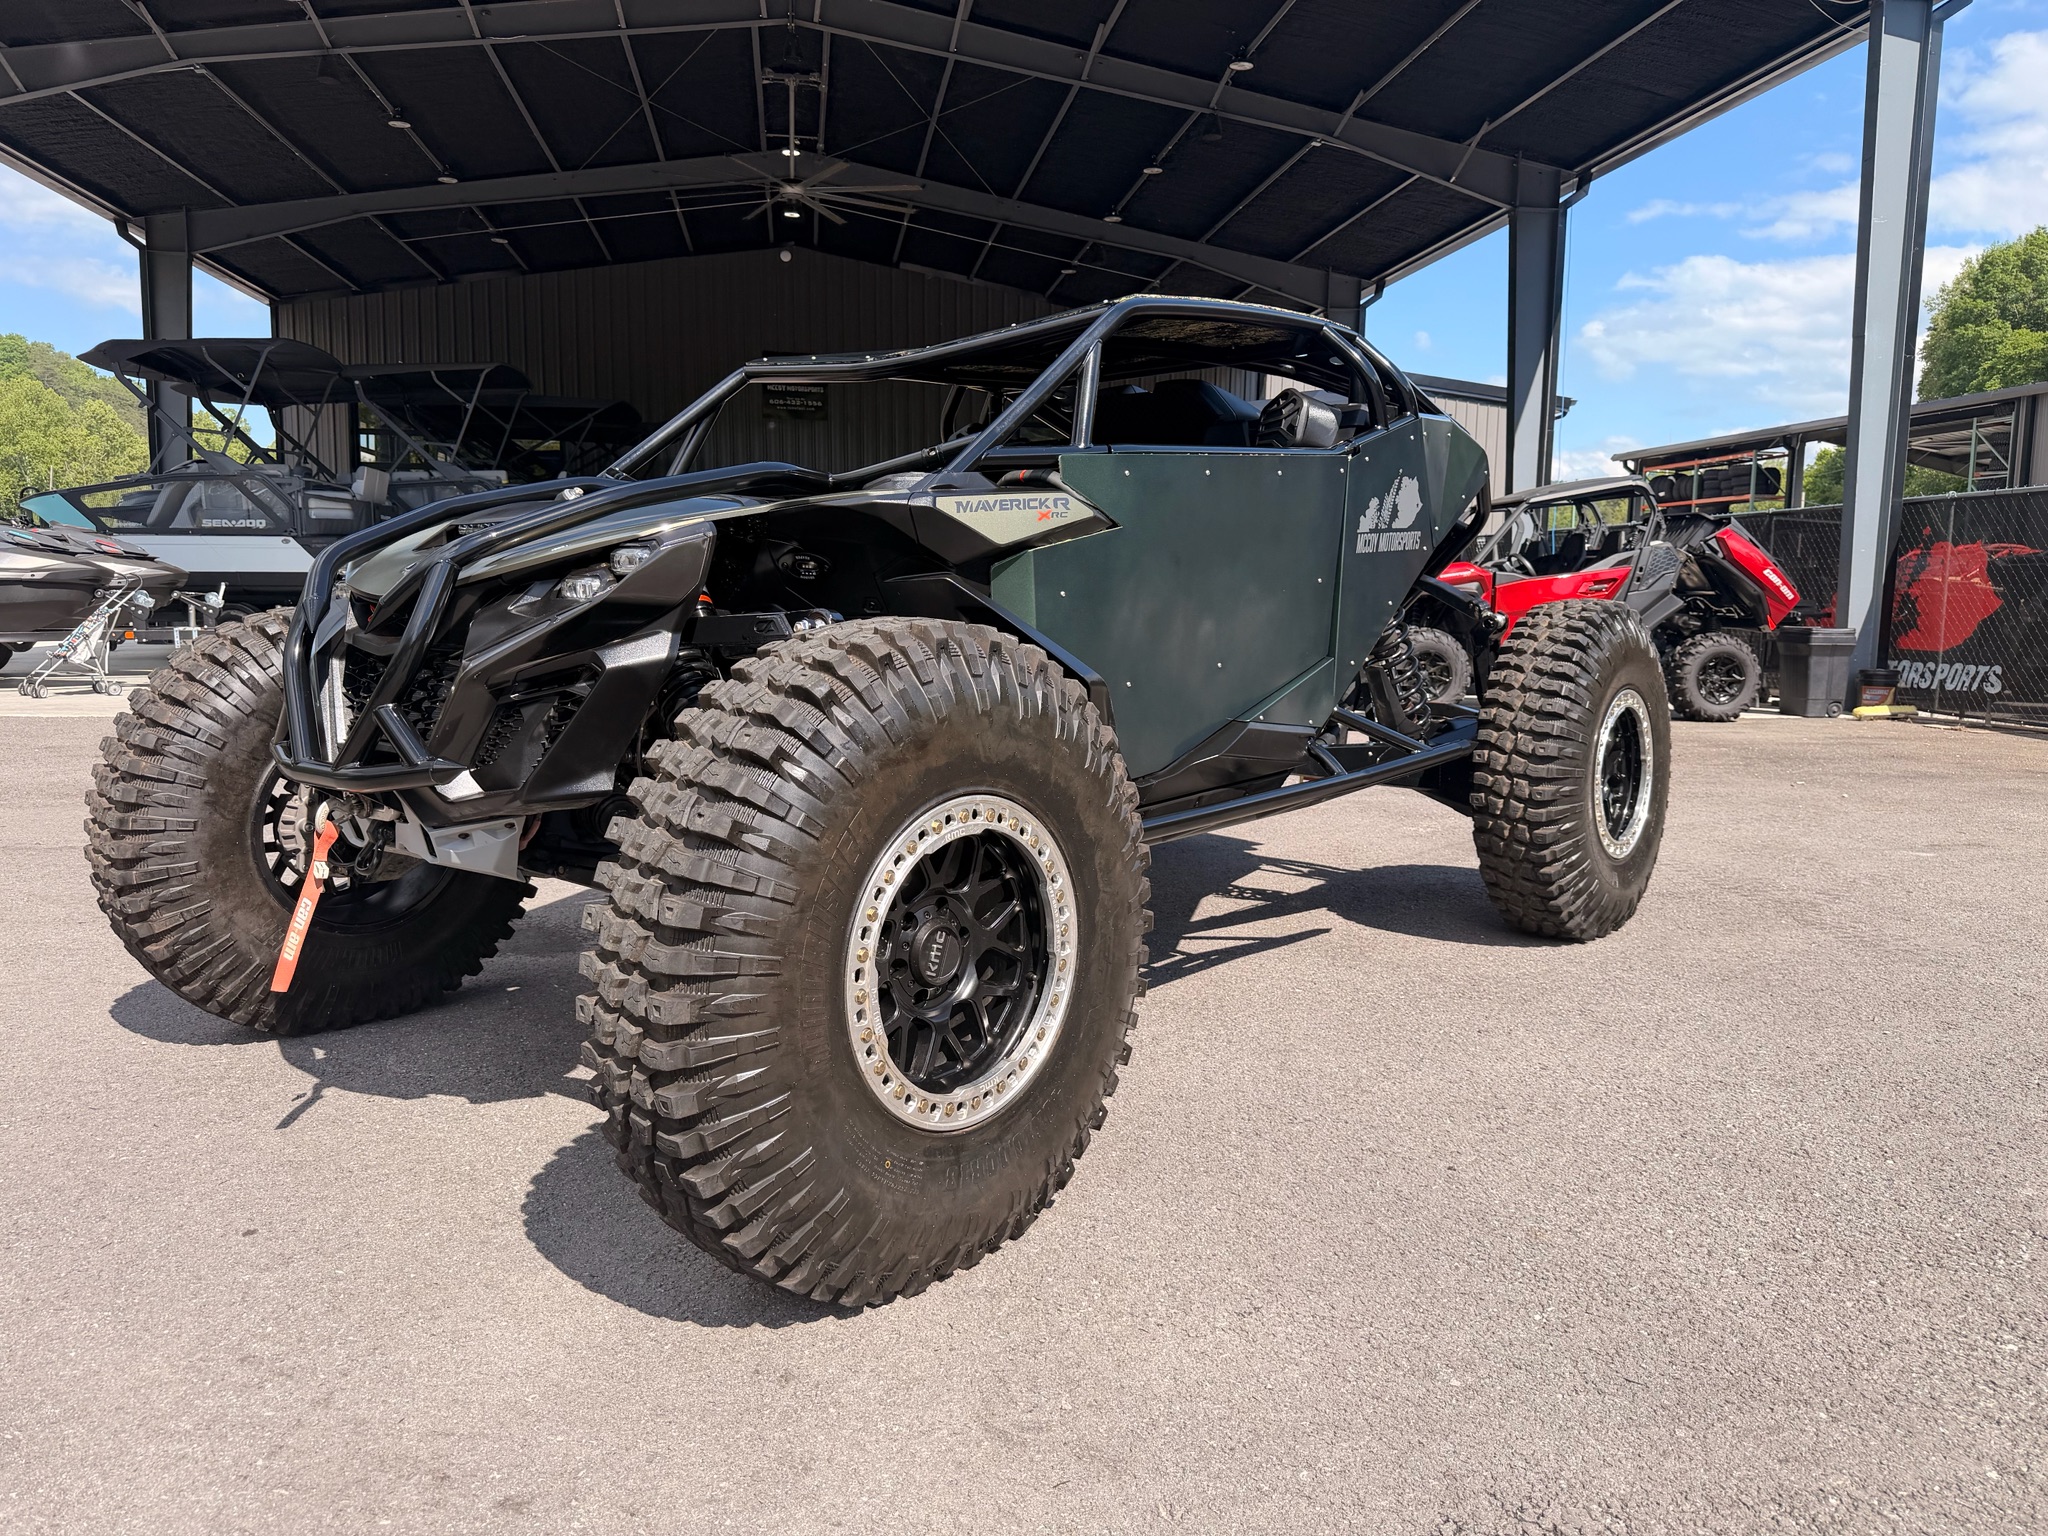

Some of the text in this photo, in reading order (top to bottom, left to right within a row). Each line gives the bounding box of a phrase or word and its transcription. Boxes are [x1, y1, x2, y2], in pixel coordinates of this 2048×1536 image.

[955, 498, 1050, 513] MAVERICK
[1356, 531, 1421, 553] MCCOY MOTORSPORTS
[925, 930, 947, 977] KMC
